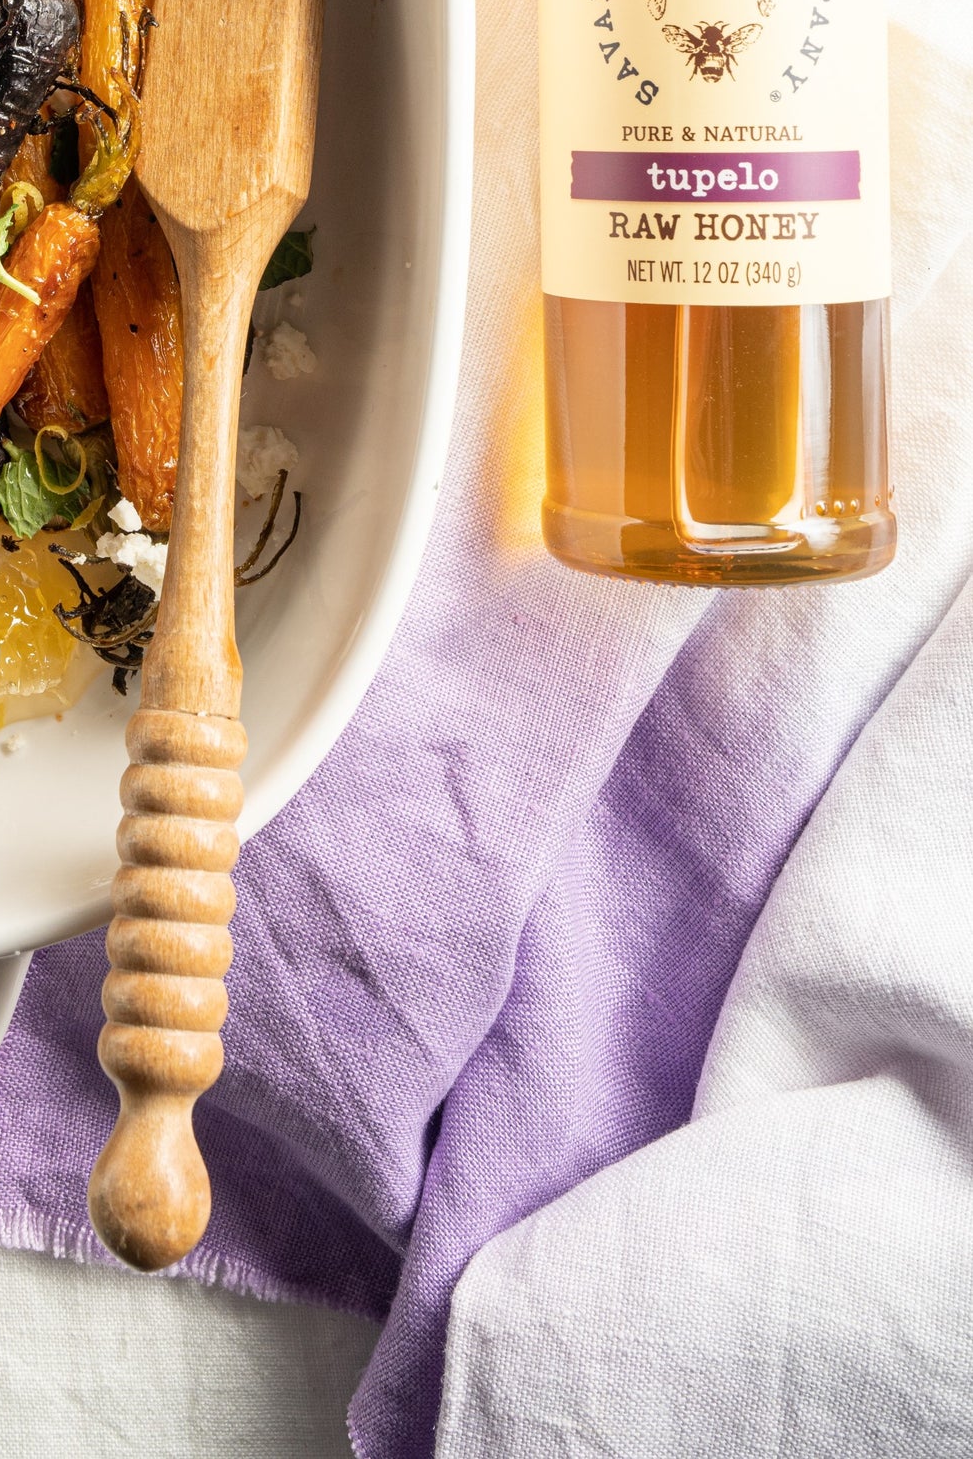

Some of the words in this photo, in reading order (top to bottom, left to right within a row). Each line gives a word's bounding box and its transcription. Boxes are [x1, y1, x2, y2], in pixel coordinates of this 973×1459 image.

[621, 125, 674, 142] PURE
[681, 126, 697, 142] &
[703, 125, 804, 142] NATURAL
[645, 161, 780, 198] tupelo
[608, 211, 681, 240] RAW
[693, 211, 820, 241] HONEY
[626, 259, 656, 283] NET
[659, 260, 687, 284] WT.
[693, 261, 712, 284] 12
[718, 261, 740, 284] OZ
[745, 260, 782, 287] (340
[787, 261, 802, 288] g)
